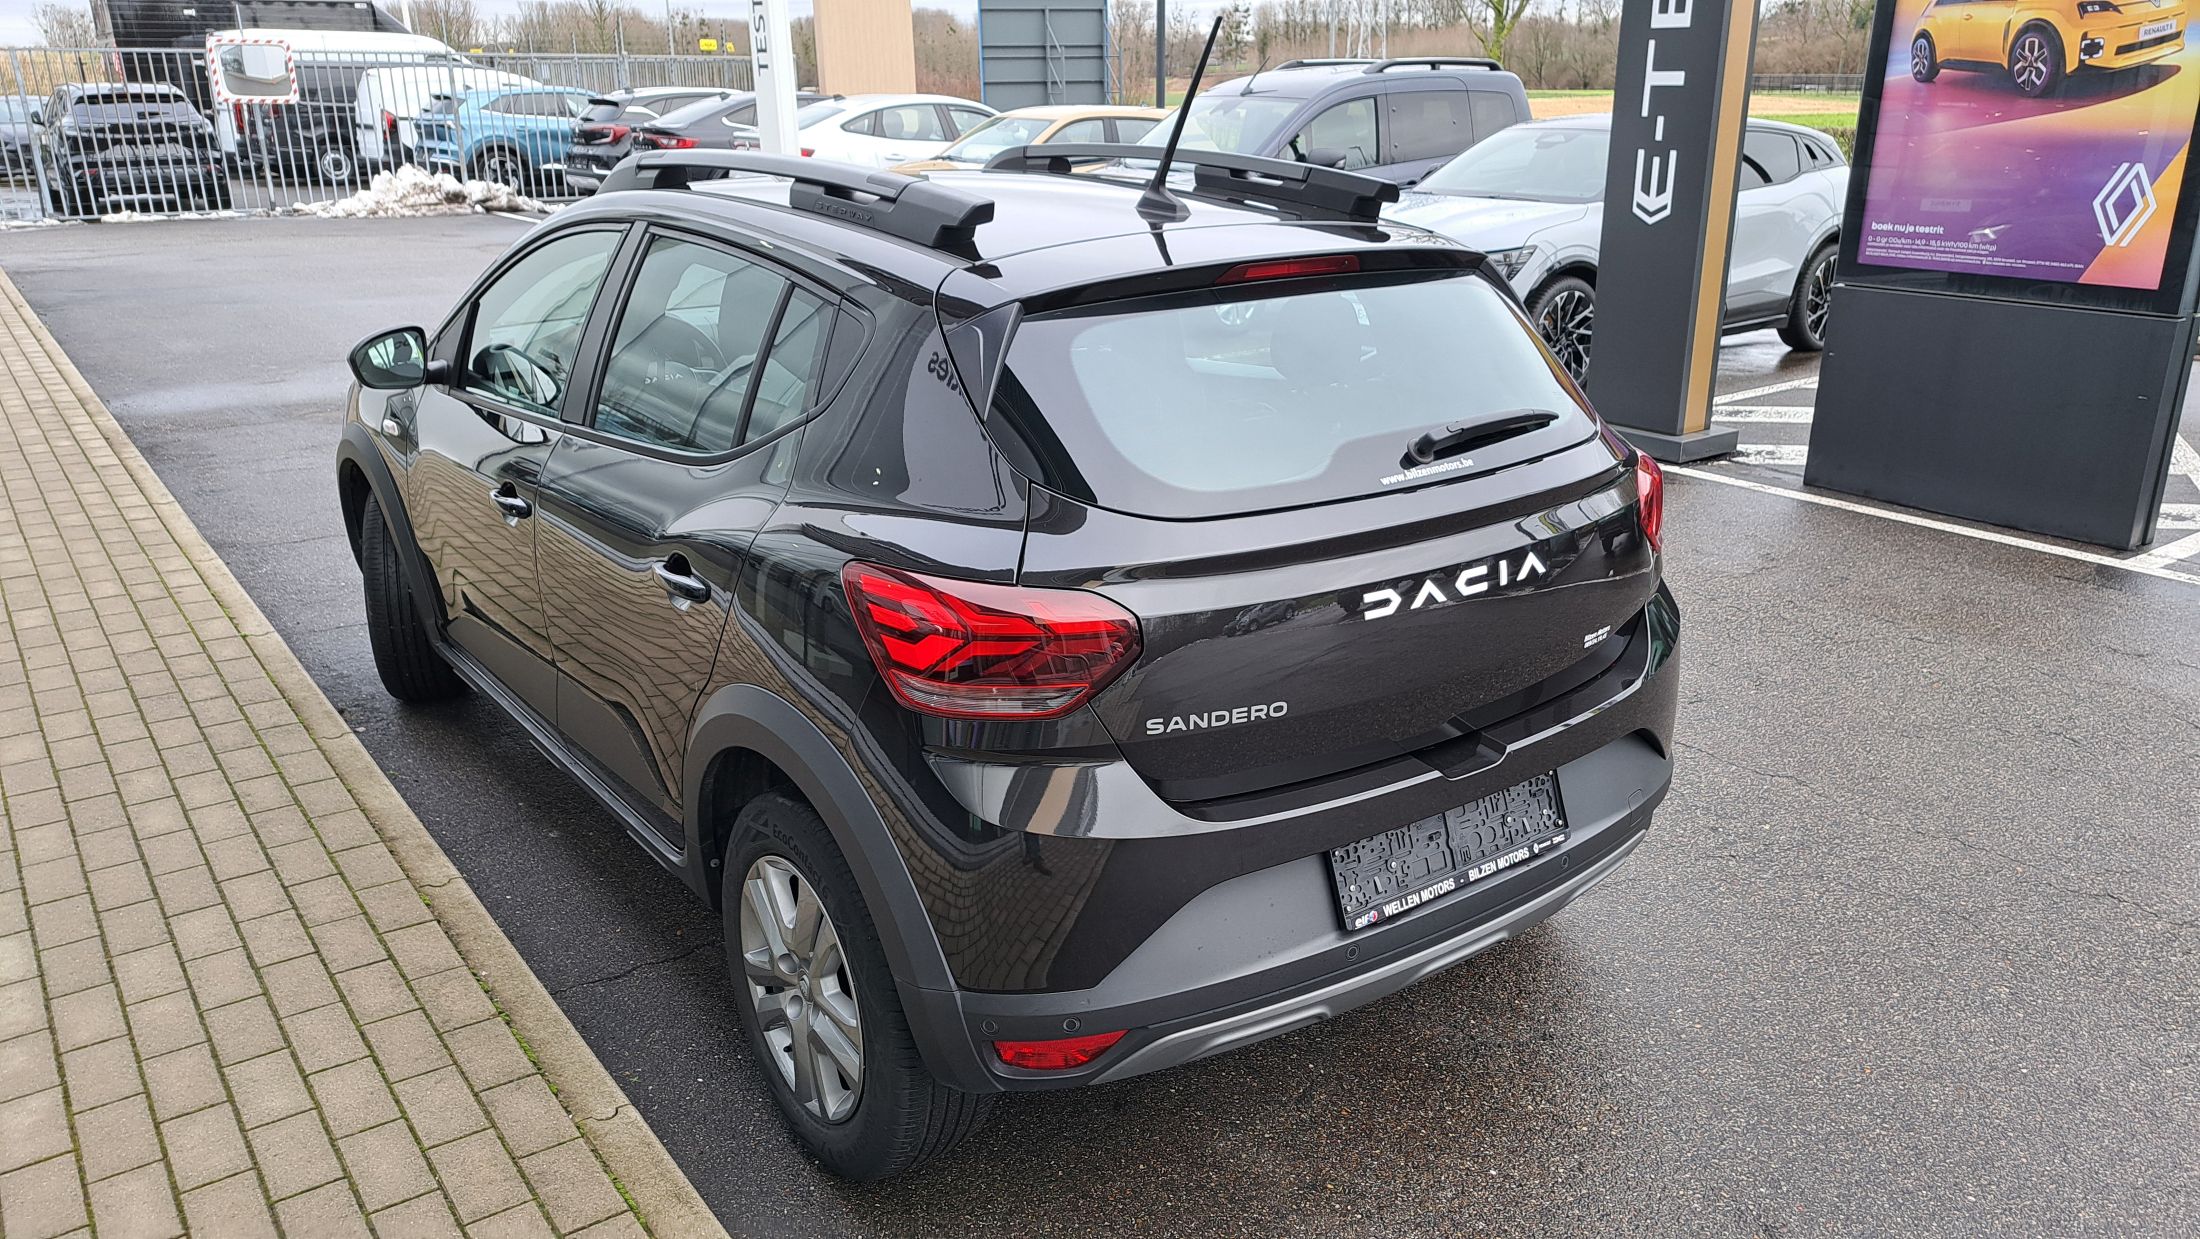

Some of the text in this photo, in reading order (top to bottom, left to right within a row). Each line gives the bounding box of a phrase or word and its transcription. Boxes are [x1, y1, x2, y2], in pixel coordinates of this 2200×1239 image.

[2144, 24, 2169, 36] RENAULT
[814, 201, 872, 222] STEPWAY
[1871, 221, 1893, 232] boek
[1380, 458, 1474, 486] www.bilzenmotors.be
[1363, 551, 1546, 621] DACIA
[1146, 700, 1289, 735] SANDERO
[1383, 893, 1420, 917] WELLEN
[1421, 878, 1455, 900] MOTORS
[1468, 860, 1497, 882] BILZEN
[1498, 846, 1530, 869] MOTORS
